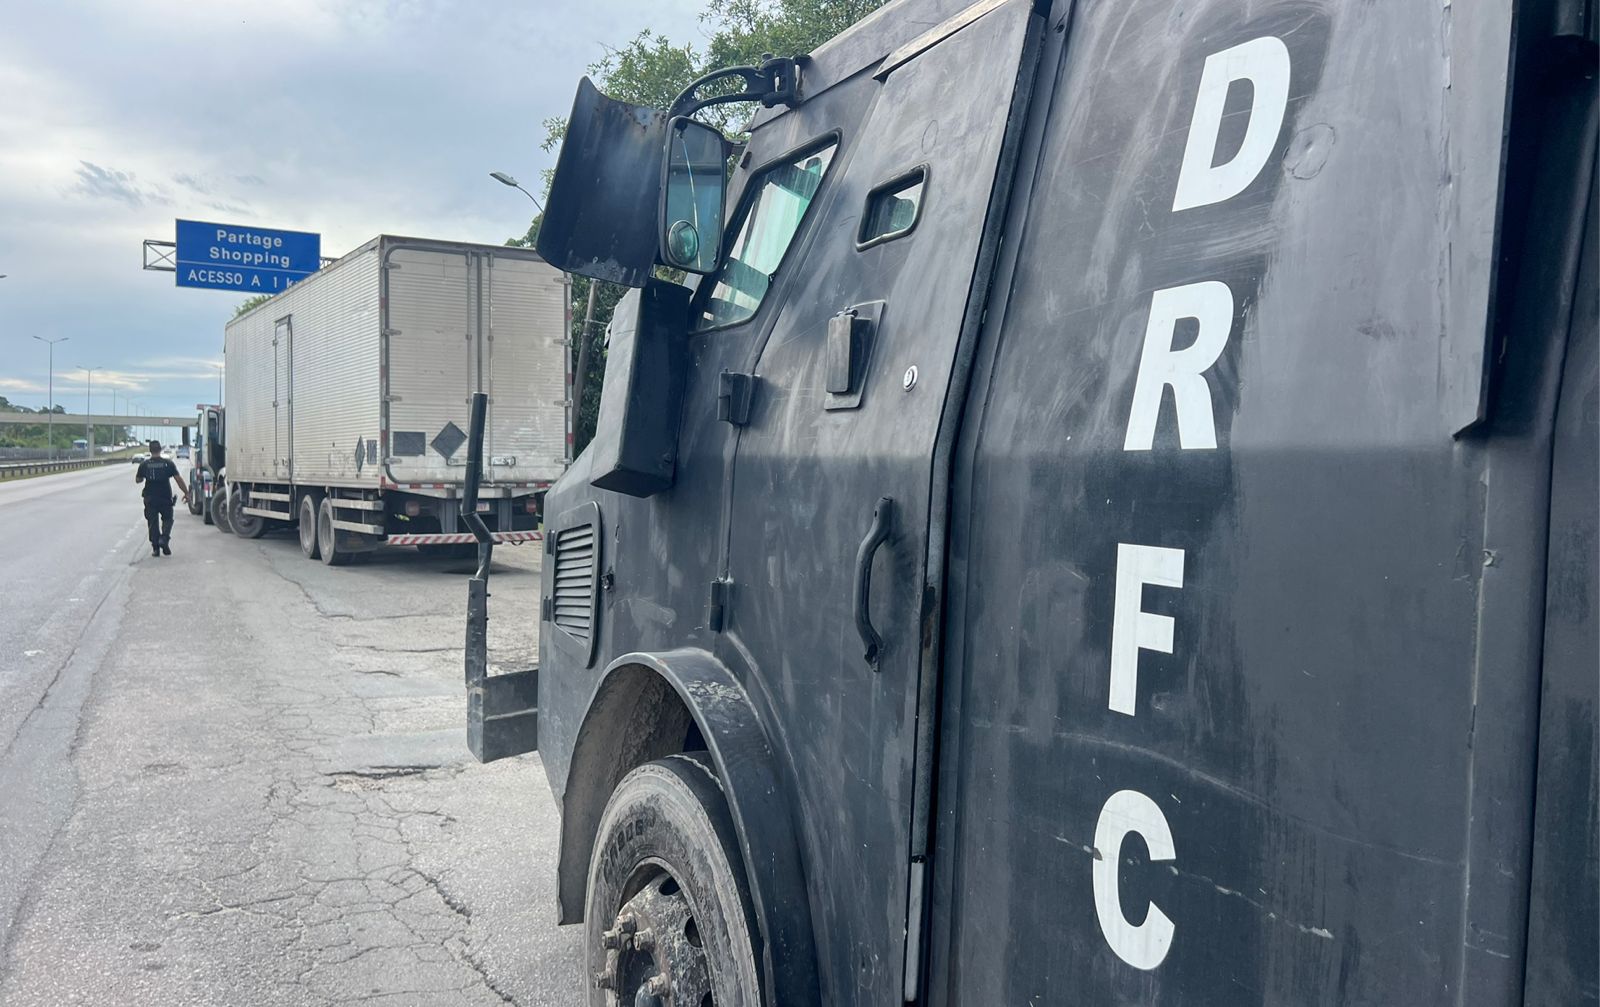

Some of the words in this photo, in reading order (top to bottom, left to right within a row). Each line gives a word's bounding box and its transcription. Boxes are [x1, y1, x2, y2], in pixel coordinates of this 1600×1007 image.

[216, 229, 283, 248] Partage
[209, 247, 290, 267] Shopping
[188, 269, 243, 286] ACESSO
[251, 275, 261, 287] A
[273, 276, 278, 288] 1
[1092, 36, 1291, 970] DRFC
